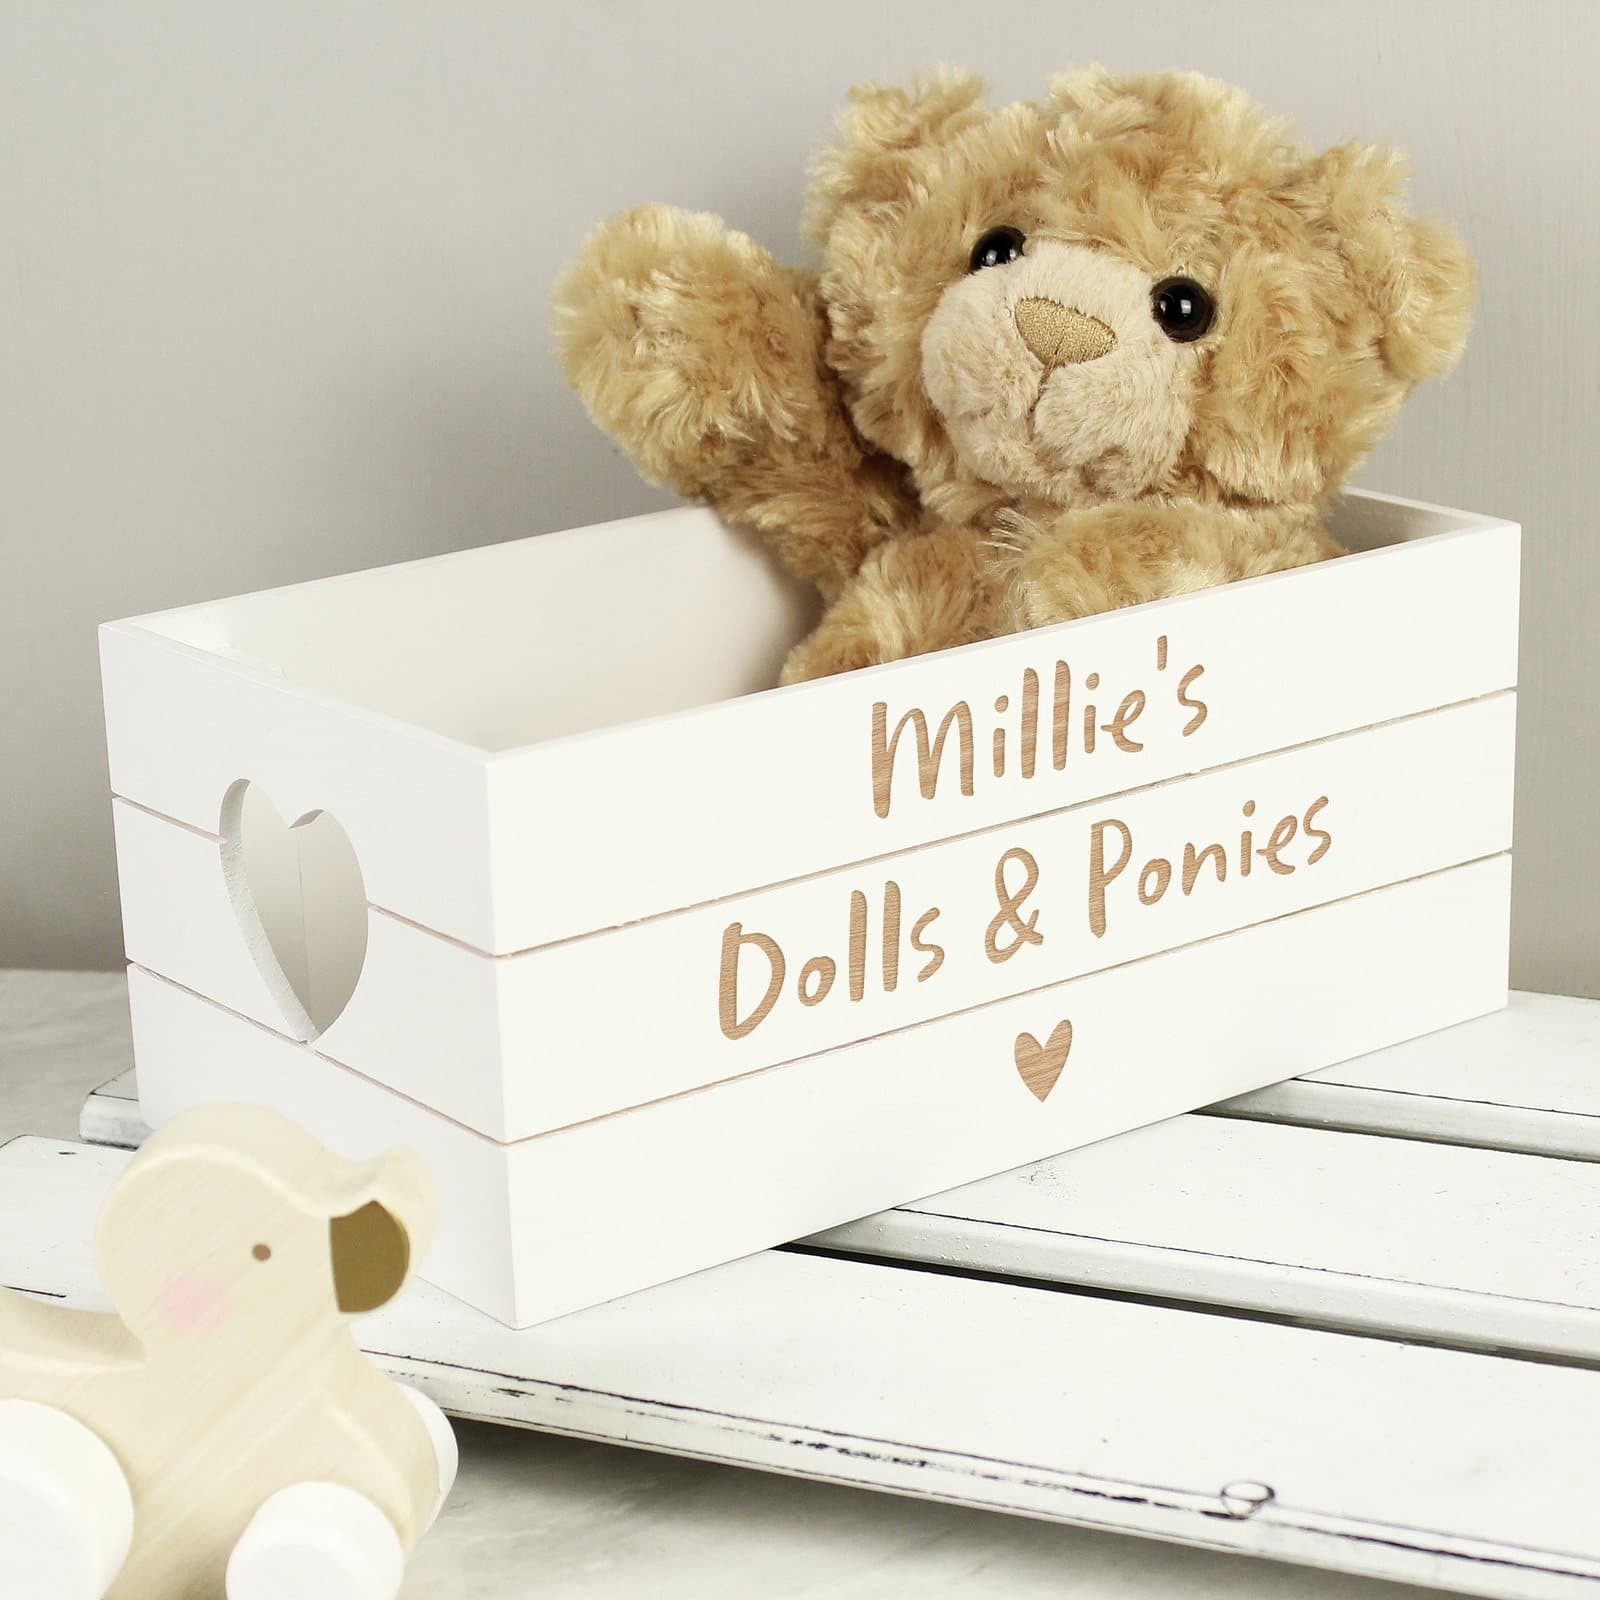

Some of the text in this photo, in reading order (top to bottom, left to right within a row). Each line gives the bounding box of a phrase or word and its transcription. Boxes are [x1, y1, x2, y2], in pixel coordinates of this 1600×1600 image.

[870, 634, 1208, 820] Millie's
[718, 795, 1333, 1041] Dolls & Ponies
